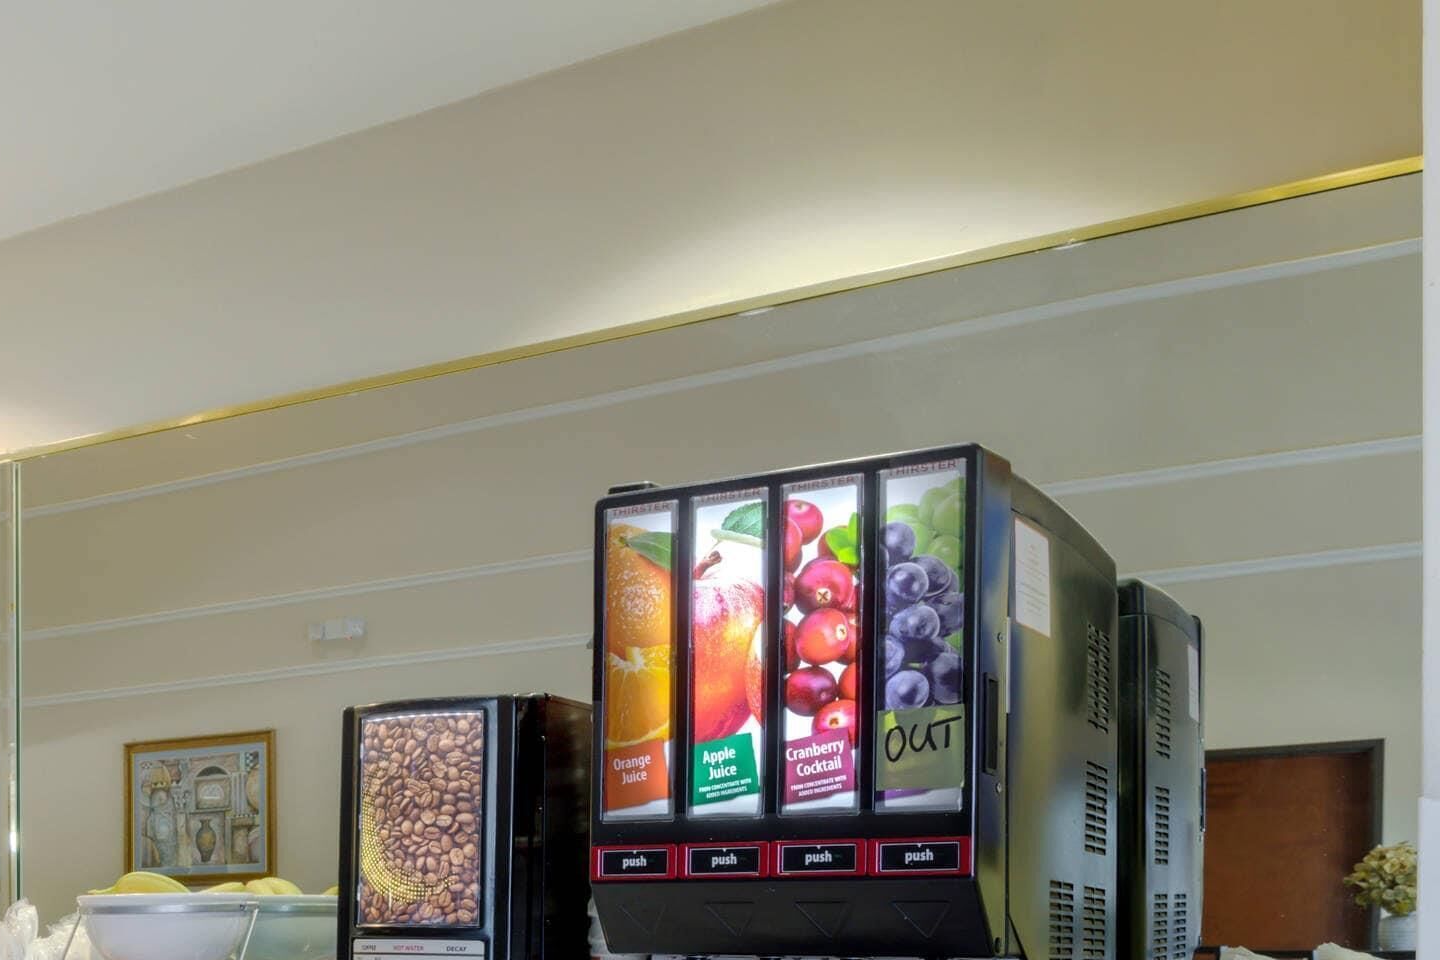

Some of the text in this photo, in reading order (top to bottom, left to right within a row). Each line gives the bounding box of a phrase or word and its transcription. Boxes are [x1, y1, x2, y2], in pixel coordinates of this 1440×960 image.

[888, 461, 957, 477] THIRSTER
[791, 476, 856, 491] THIRSTER
[613, 503, 668, 516] THIRSTER
[885, 716, 962, 763] OUT
[702, 747, 736, 766] Apple
[786, 740, 845, 762] Cranberry
[613, 754, 652, 771] Orange
[796, 756, 842, 777] Cocktail
[622, 770, 648, 785] Juice
[709, 765, 737, 780] Juice
[622, 855, 647, 870] push
[711, 853, 737, 868] push
[805, 850, 832, 866] push
[905, 849, 934, 864] push
